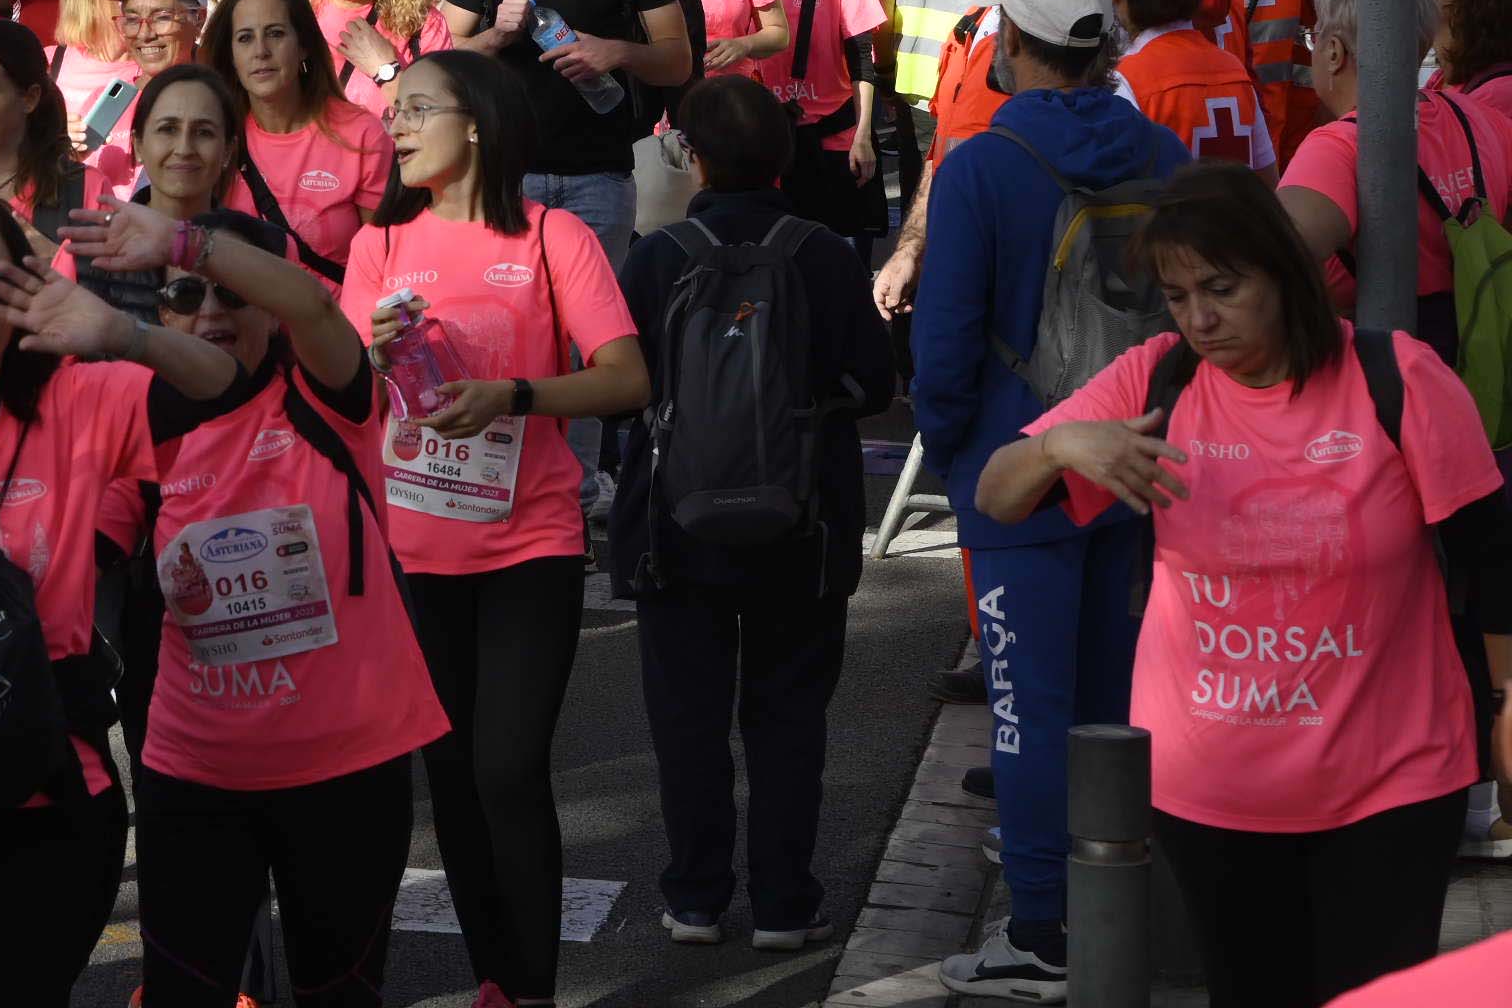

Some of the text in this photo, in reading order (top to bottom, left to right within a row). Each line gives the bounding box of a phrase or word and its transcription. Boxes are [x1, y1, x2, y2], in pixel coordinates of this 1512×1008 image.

[488, 271, 530, 282] ASTURIANA
[425, 439, 470, 461] 016
[426, 462, 461, 478] 16484
[394, 471, 426, 485] CARRERA
[427, 477, 438, 487] DE
[439, 480, 450, 489] LA
[451, 482, 478, 495] MUJER
[390, 485, 425, 504] OYSHO
[457, 501, 501, 514] Santander
[205, 540, 263, 559] ASTURIANA
[215, 570, 269, 597] 016
[1182, 571, 1231, 608] TU
[225, 597, 266, 616] 10415
[191, 624, 233, 638] CARRERA
[232, 622, 246, 631] DE
[247, 618, 259, 627] LA
[260, 611, 292, 625] MUJER
[273, 626, 324, 643] Santander
[1195, 621, 1363, 663] DORSAL
[978, 585, 1020, 754] BARÇA
[1191, 669, 1318, 712] SUMA
